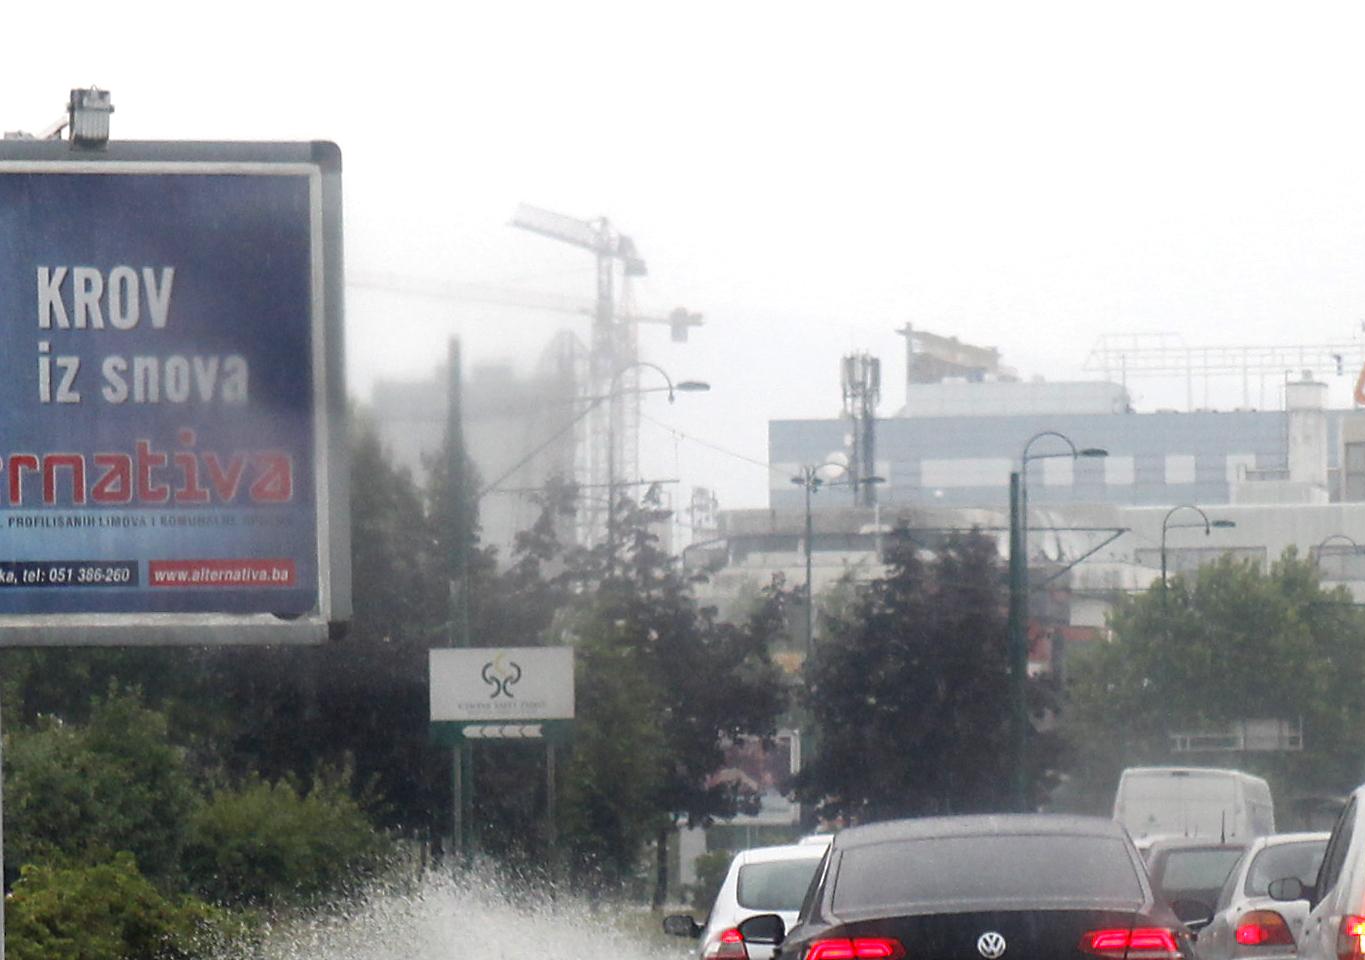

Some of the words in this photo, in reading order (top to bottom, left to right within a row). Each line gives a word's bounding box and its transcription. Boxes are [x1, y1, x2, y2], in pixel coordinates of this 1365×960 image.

[36, 265, 175, 330] KROV
[38, 341, 81, 403] iz
[102, 353, 249, 403] snova
[0, 427, 294, 506] rnativa
[22, 567, 46, 583] tel:
[49, 567, 73, 582] 051
[155, 566, 289, 583] www.alternativa.ba
